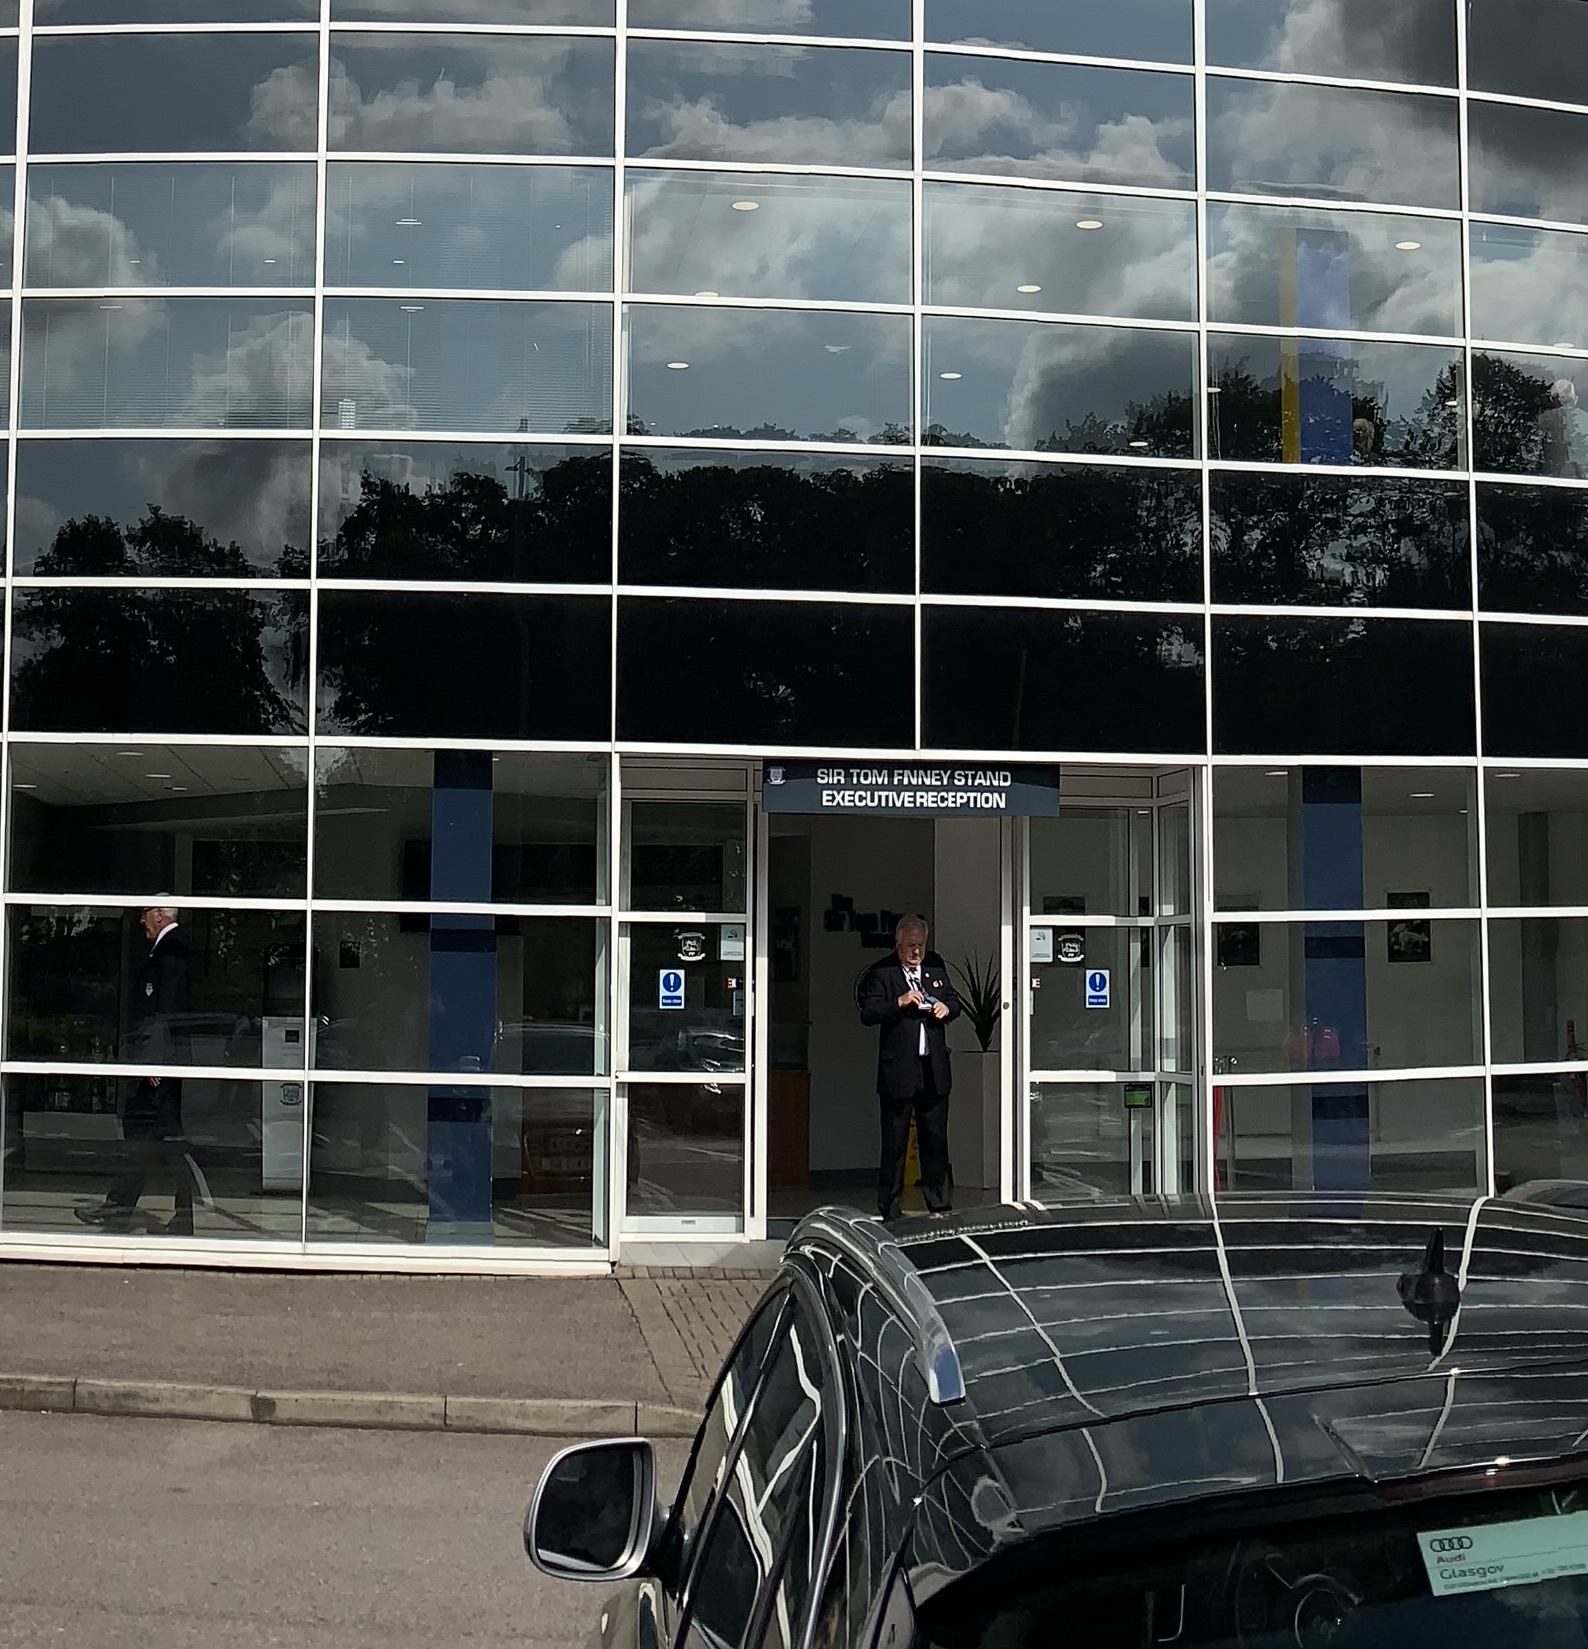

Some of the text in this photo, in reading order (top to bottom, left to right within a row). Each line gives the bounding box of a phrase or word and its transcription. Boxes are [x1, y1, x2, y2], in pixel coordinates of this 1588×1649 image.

[816, 768, 846, 785] SIR
[849, 769, 889, 785] TOM
[953, 770, 1012, 787] STAND
[821, 790, 1006, 809] EXECUTIVE RECEPTION
[1436, 1554, 1466, 1564] Audi
